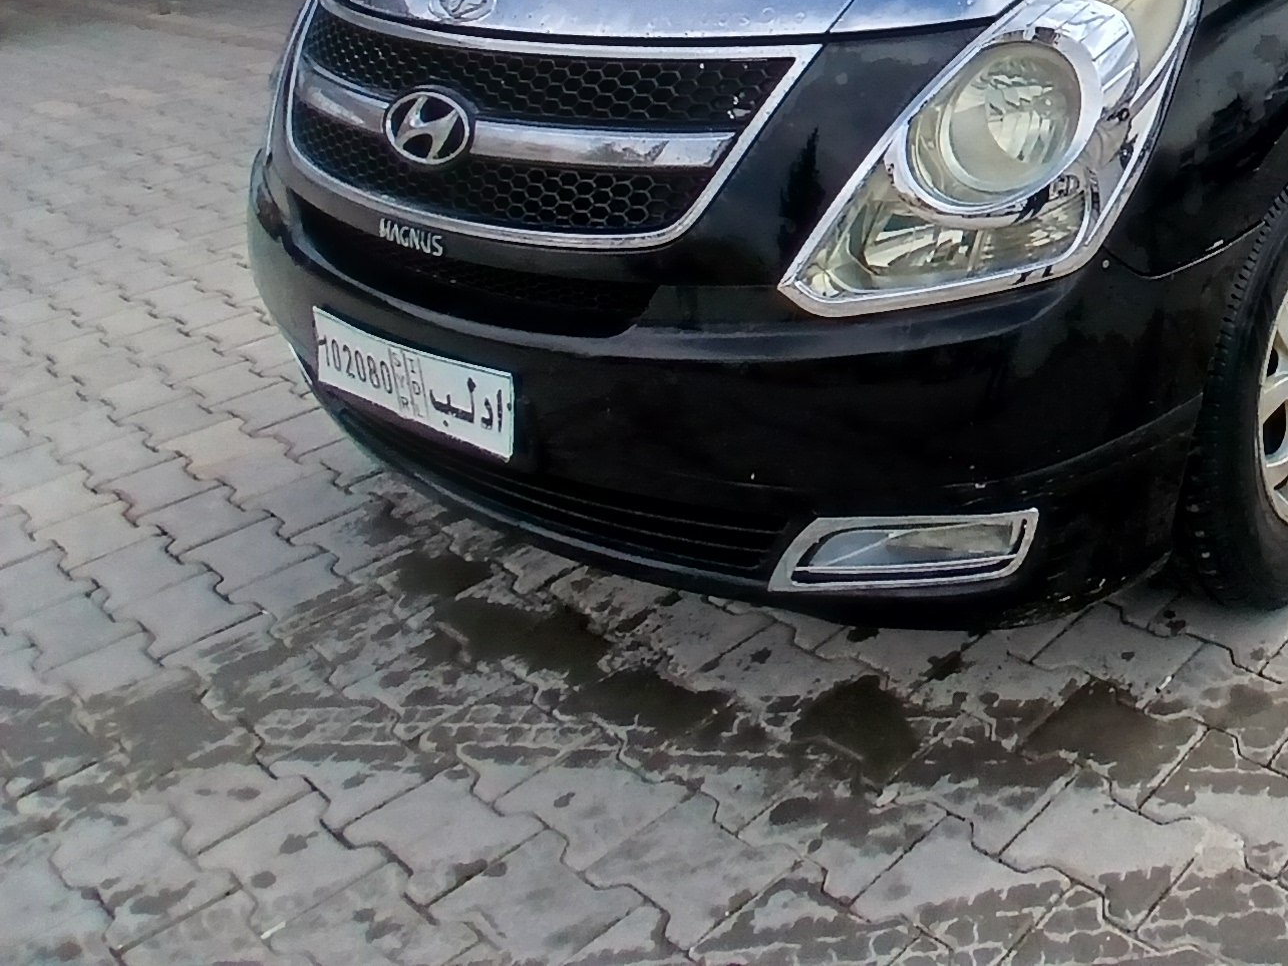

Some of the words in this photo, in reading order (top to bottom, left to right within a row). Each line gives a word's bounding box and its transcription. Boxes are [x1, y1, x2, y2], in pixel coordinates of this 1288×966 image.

[379, 218, 444, 257] MAGNUS
[318, 334, 394, 394] 102080
[429, 377, 503, 434] ادلب
